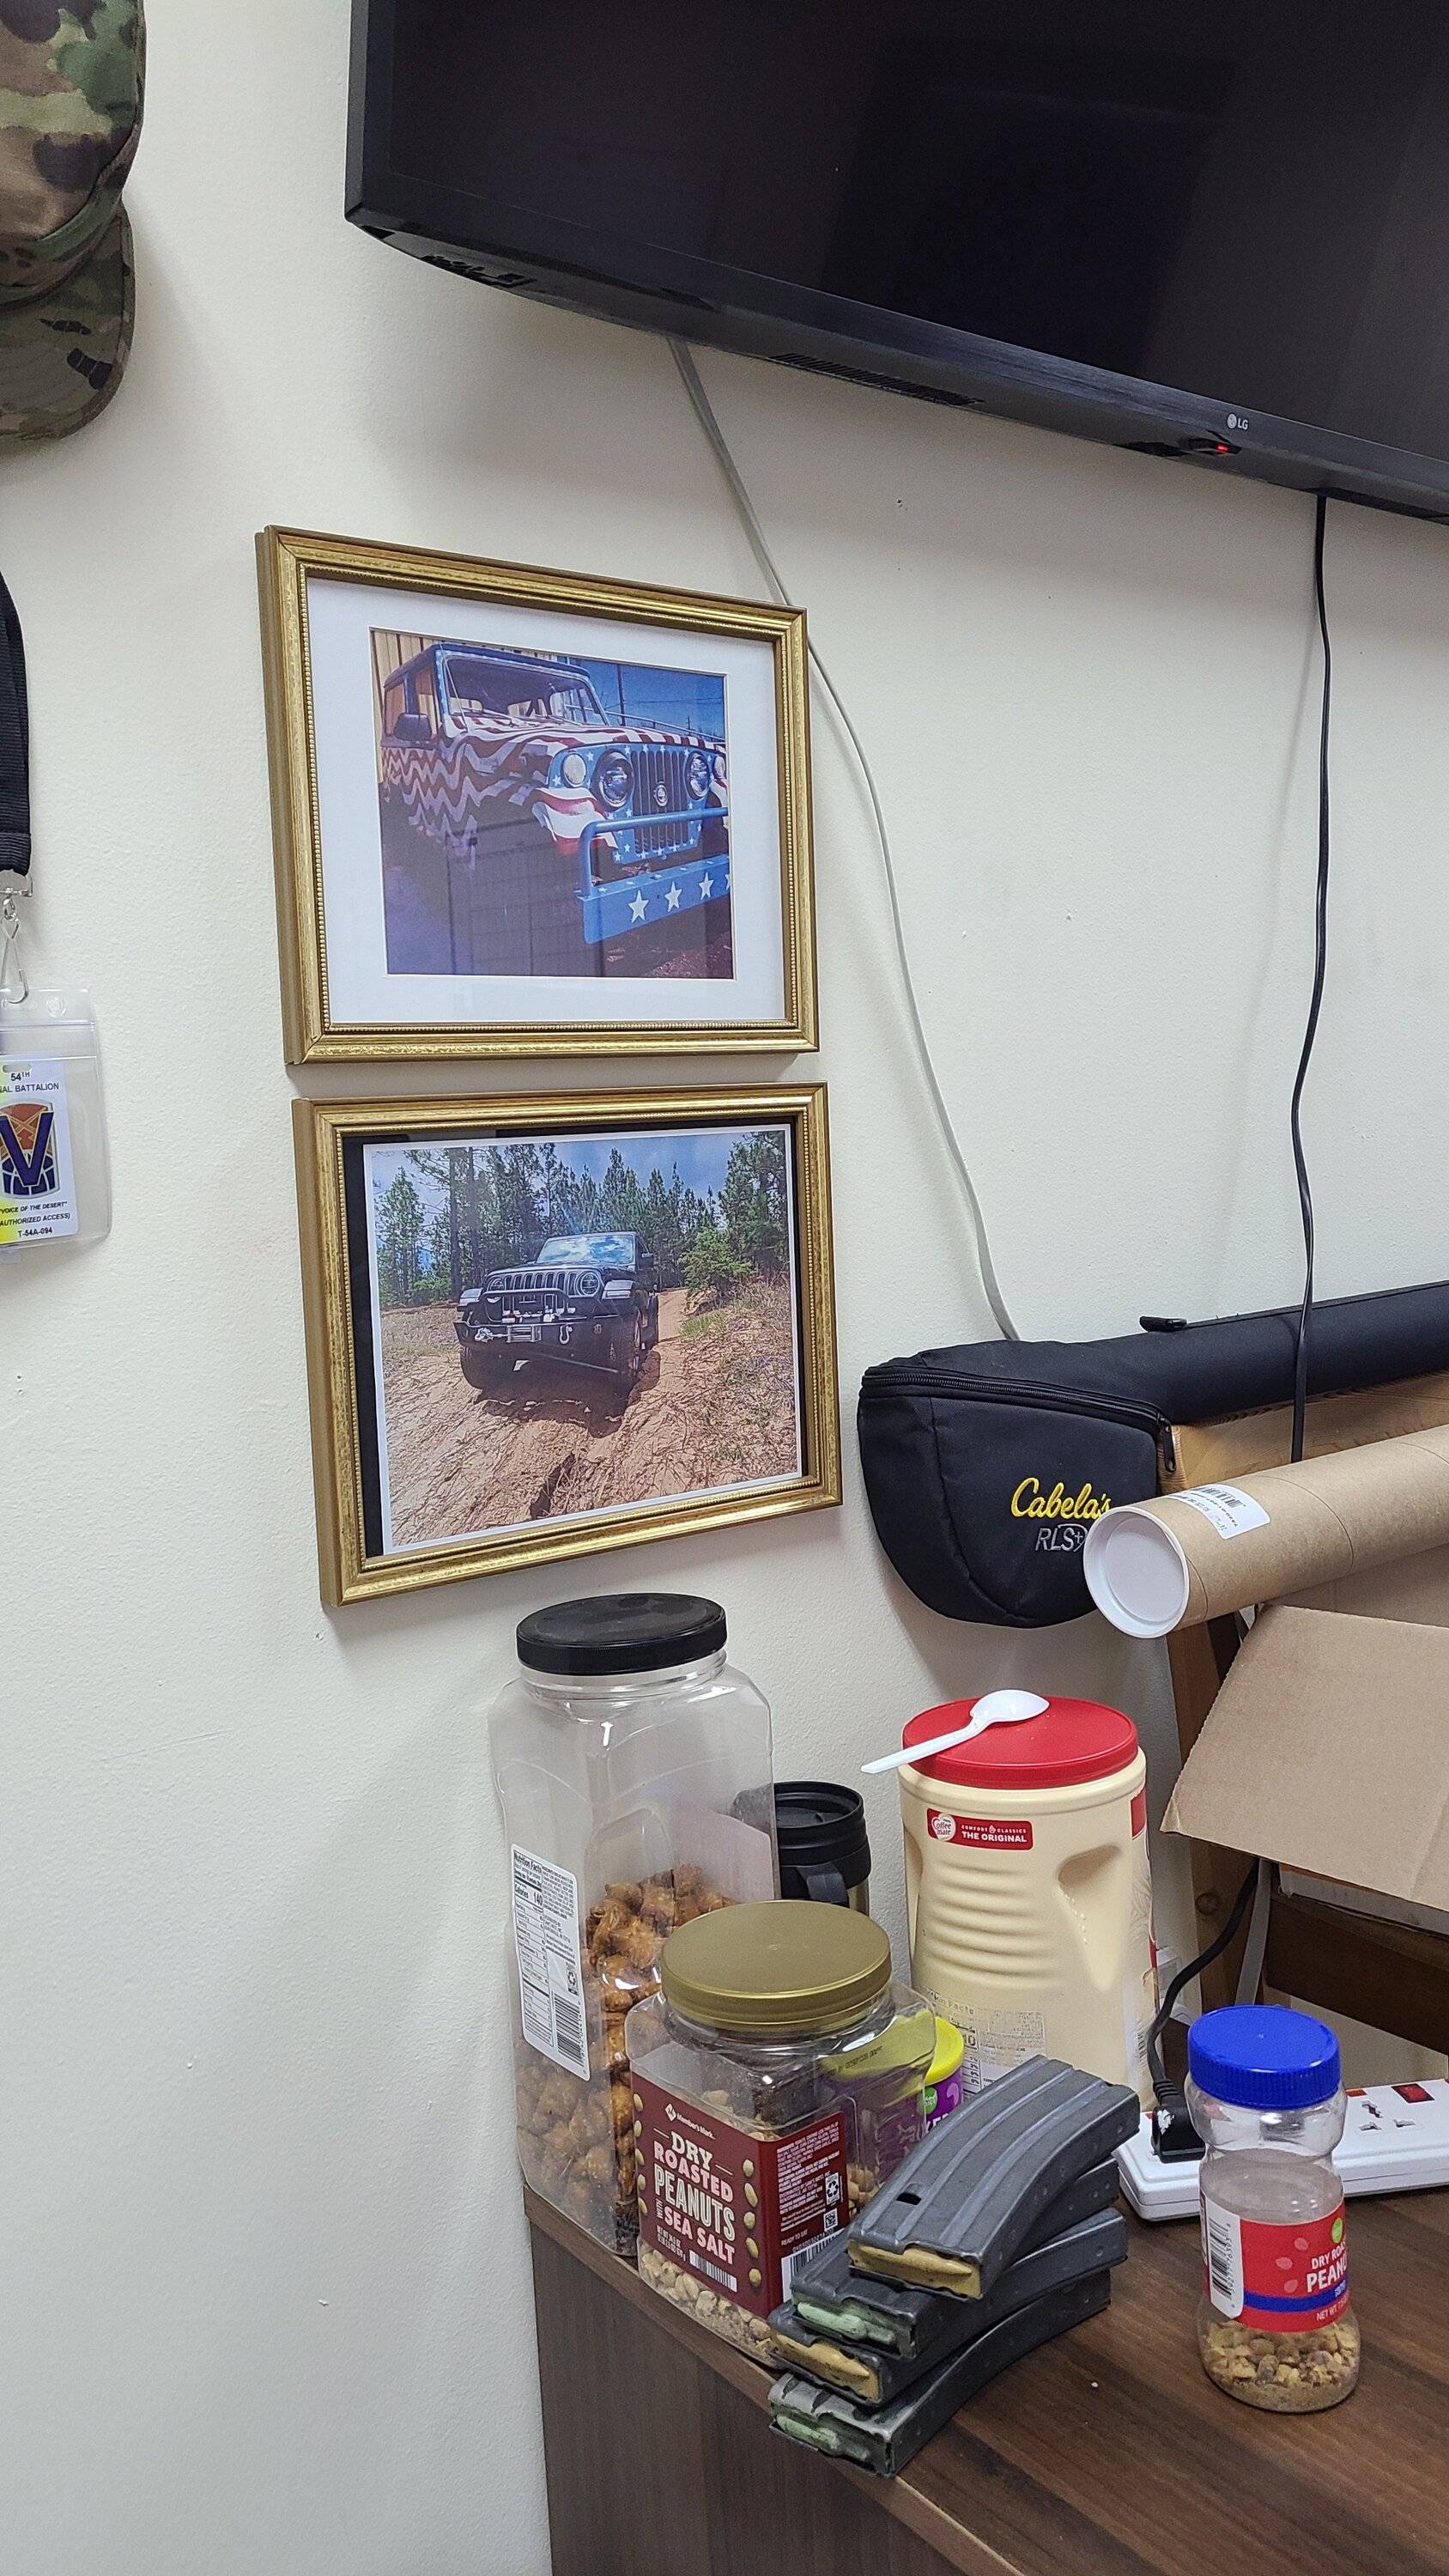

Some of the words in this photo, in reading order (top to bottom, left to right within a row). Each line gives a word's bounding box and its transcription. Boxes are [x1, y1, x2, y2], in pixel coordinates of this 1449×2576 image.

[1237, 417, 1249, 430] LG
[10, 1072, 30, 1081] 54TH
[15, 1083, 59, 1092] BATTALION
[1010, 1477, 1111, 1520] Cabela's
[961, 1831, 979, 1840] THE
[981, 1834, 1028, 1843] ORIGINAL
[670, 2130, 713, 2172] DRY
[653, 2140, 734, 2202] ROASTED
[654, 2163, 736, 2242] PEANUTS
[664, 2206, 694, 2240] SEA
[696, 2227, 736, 2265] SALT
[1311, 2251, 1330, 2270] DRY
